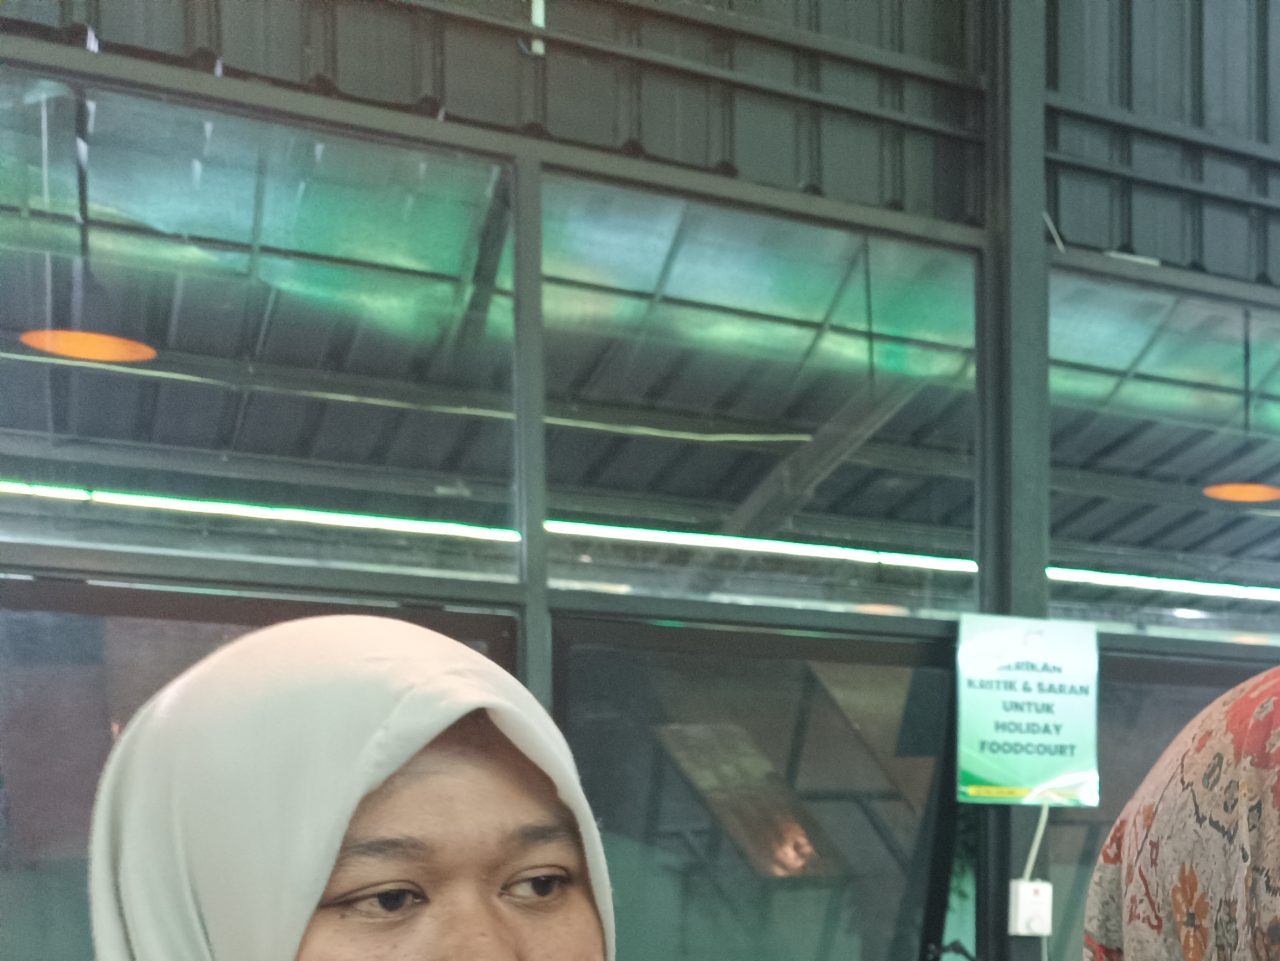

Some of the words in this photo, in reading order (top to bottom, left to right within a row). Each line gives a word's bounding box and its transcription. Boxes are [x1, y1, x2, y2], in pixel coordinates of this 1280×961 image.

[967, 679, 1016, 692] KRITIK
[1022, 681, 1032, 692] &
[1038, 682, 1089, 695] SARAN
[1002, 701, 1054, 715] UNTUK
[994, 721, 1062, 735] HOLIDAY
[980, 740, 1076, 757] FOODCOURT
